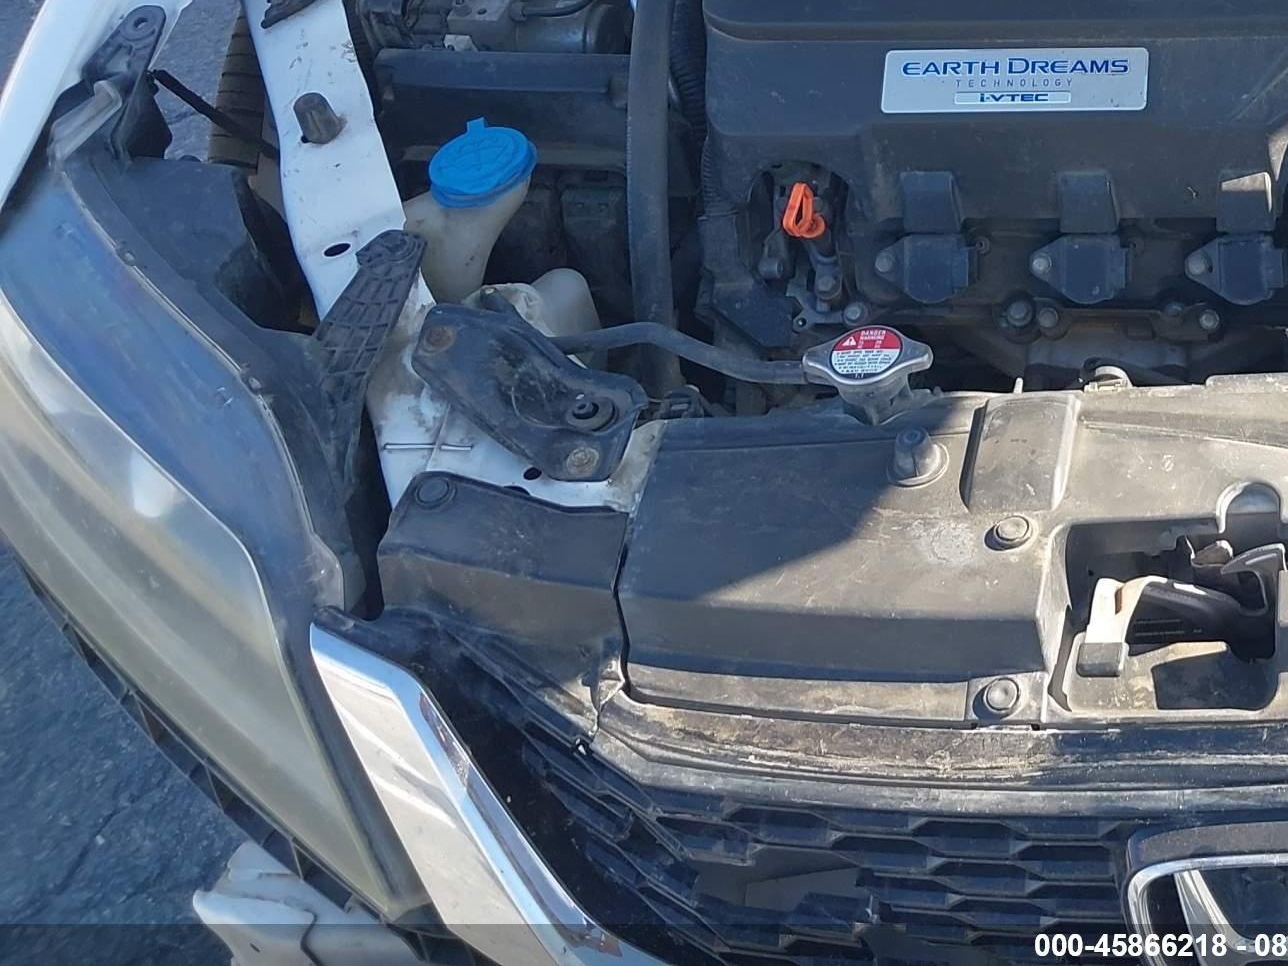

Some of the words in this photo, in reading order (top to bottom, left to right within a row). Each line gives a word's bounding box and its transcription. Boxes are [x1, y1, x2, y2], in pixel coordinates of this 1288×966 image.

[902, 60, 1000, 76] EARTH
[1007, 57, 1129, 75] DREAMS
[956, 79, 1073, 88] TECHNOLOGY
[979, 93, 1050, 103] i-VTEC
